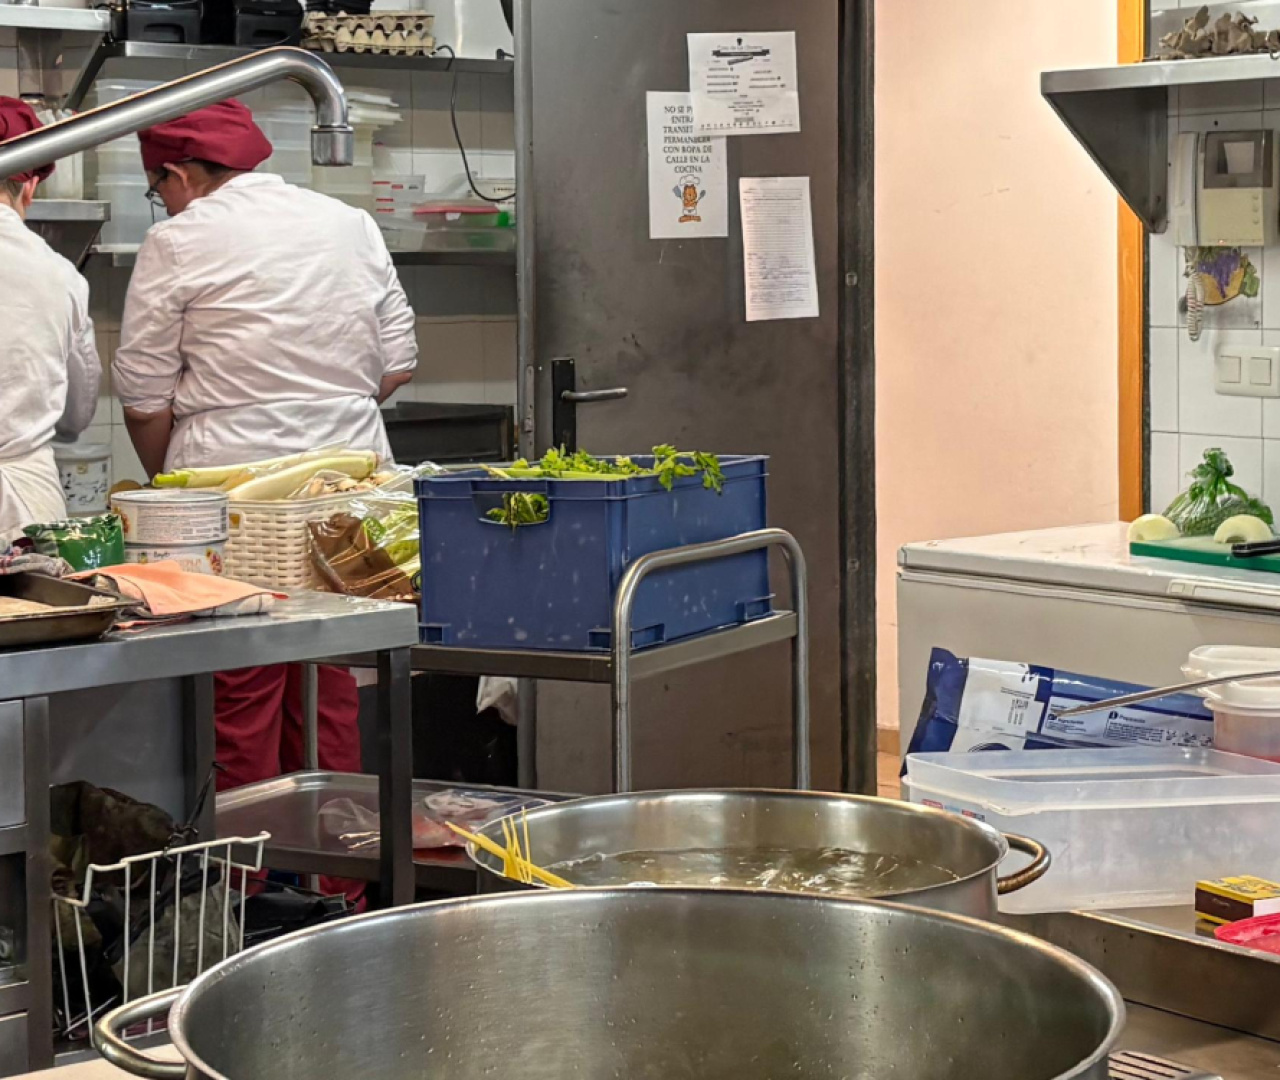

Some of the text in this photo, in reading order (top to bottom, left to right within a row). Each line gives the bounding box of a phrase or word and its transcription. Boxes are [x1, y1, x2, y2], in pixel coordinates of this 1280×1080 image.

[664, 106, 676, 114] NO
[664, 136, 711, 144] PERMANECER
[681, 145, 701, 154] ROPA
[703, 145, 712, 153] DE
[666, 155, 710, 164] CALLE EN LA
[674, 165, 703, 174] COCINA
